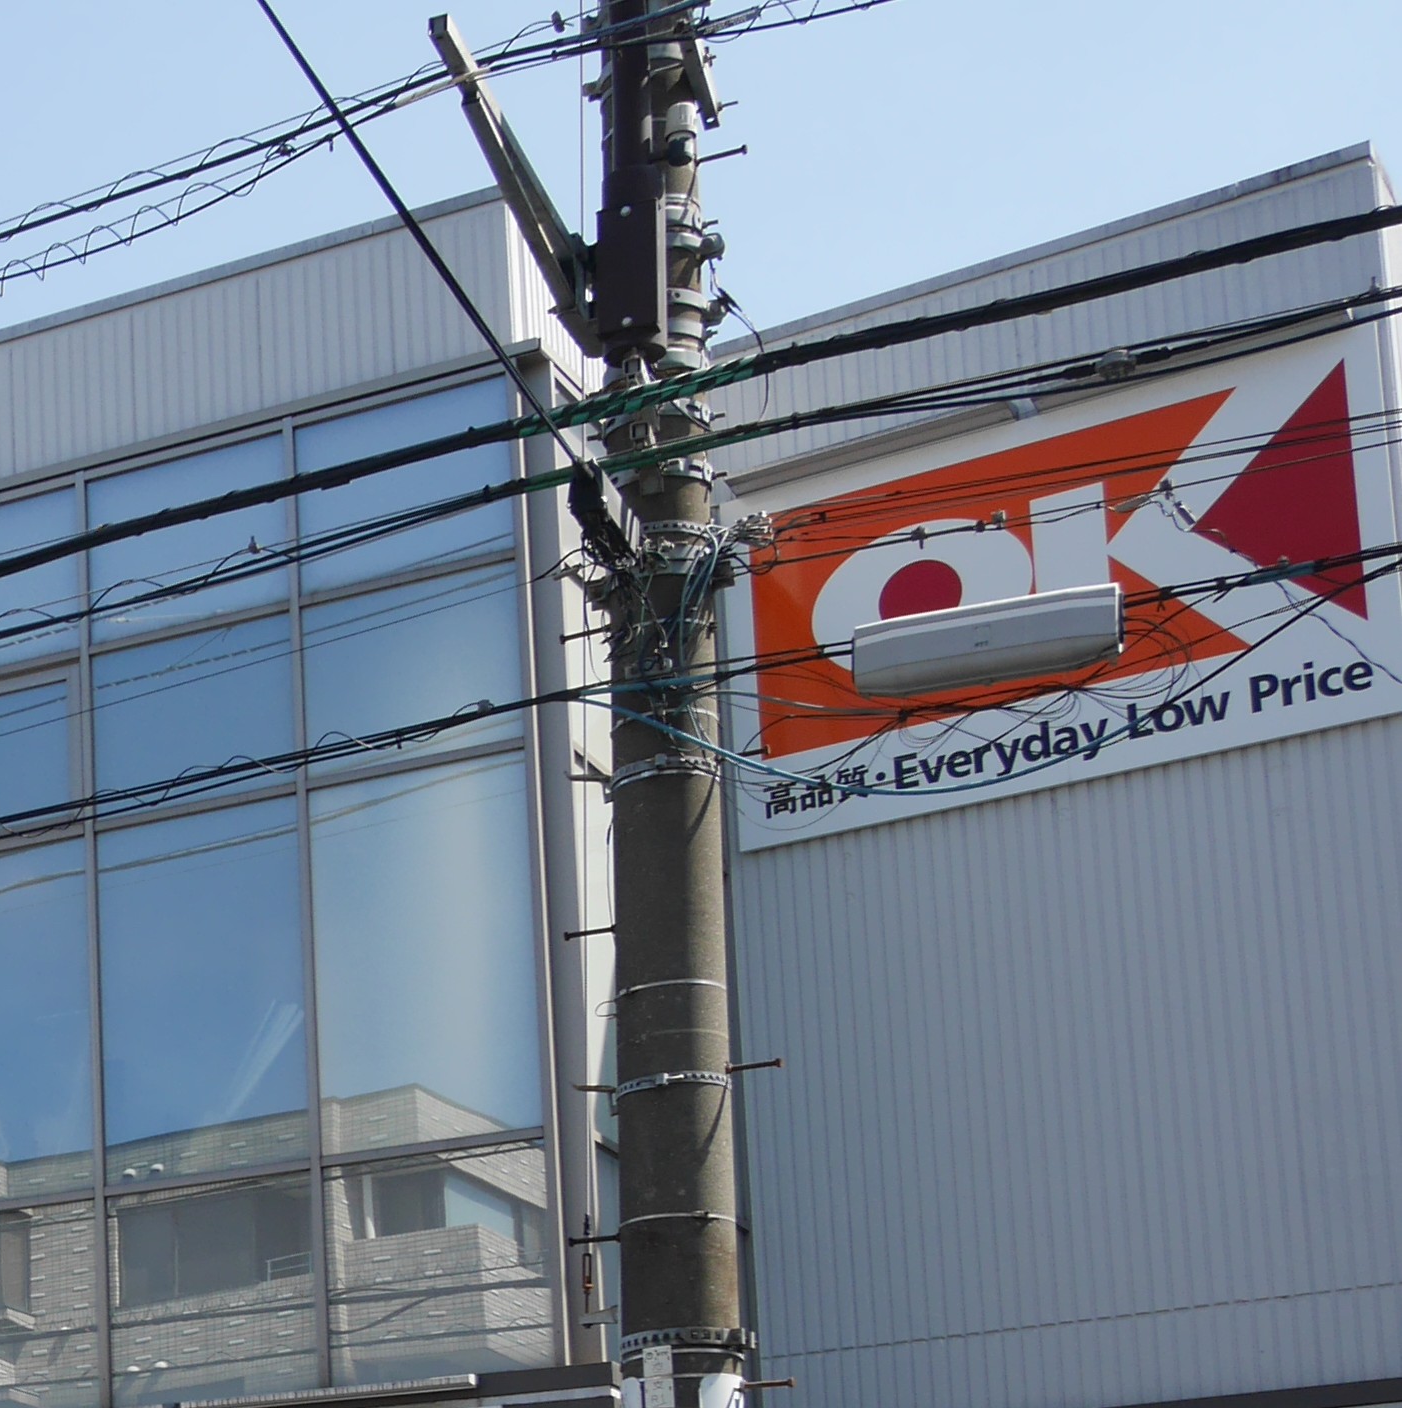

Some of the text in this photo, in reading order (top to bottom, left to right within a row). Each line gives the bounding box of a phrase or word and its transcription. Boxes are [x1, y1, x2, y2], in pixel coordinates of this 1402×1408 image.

[811, 372, 1347, 688] OK
[1126, 690, 1231, 736] Low
[1249, 658, 1374, 713] Price
